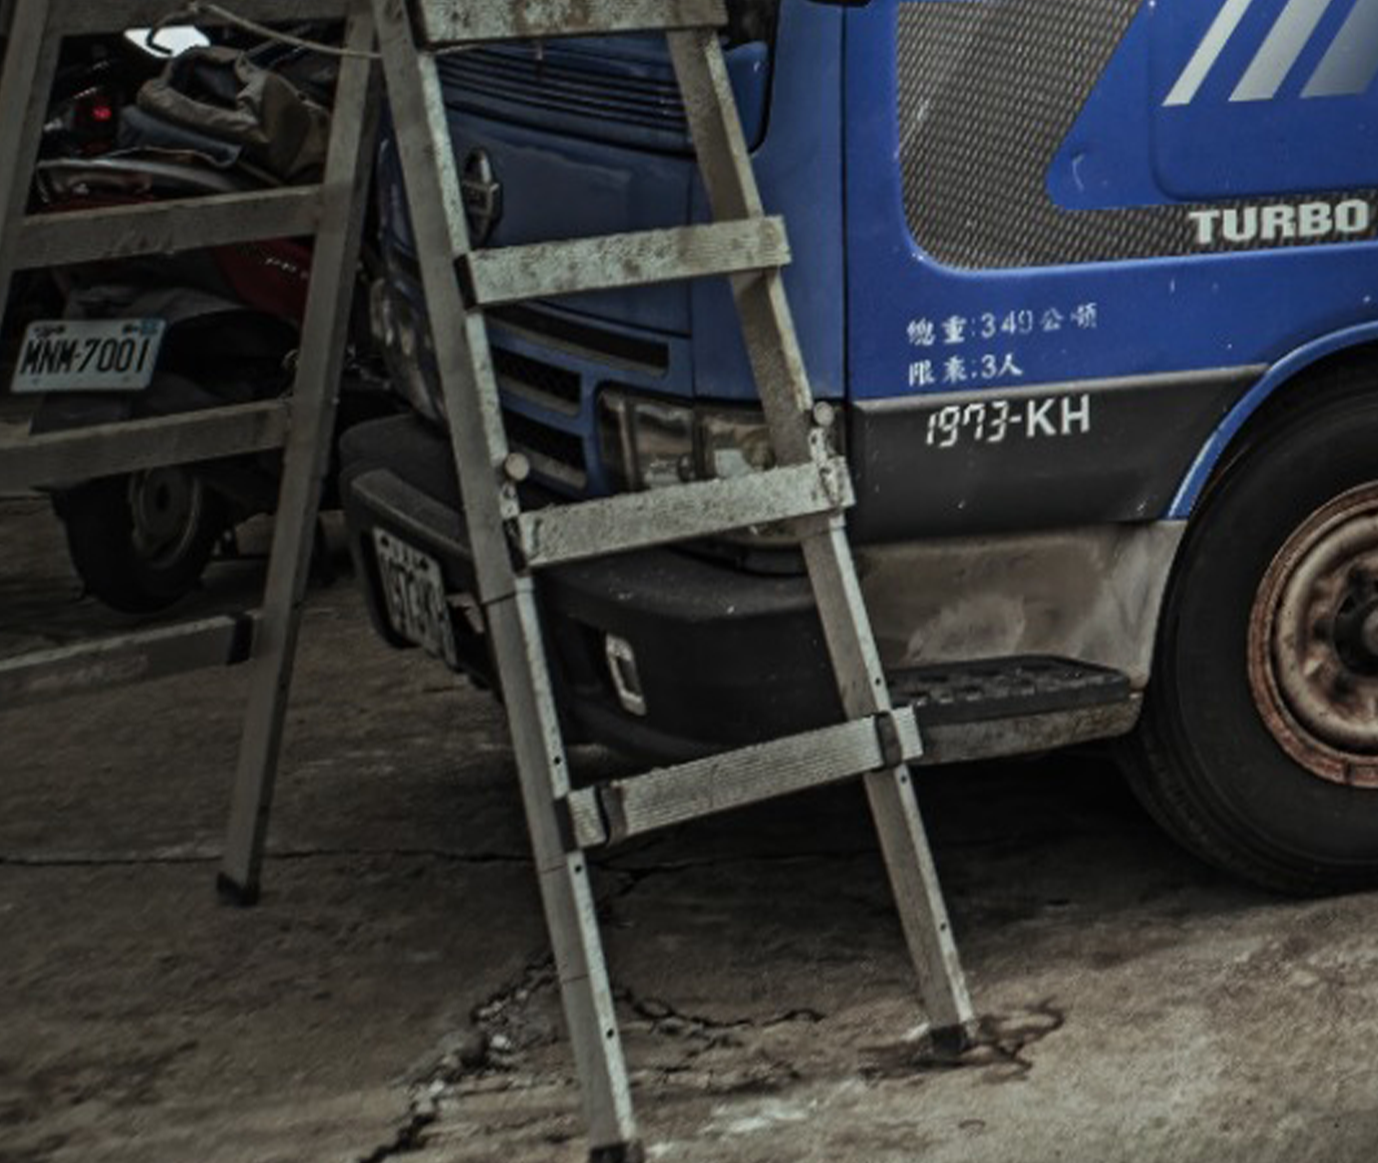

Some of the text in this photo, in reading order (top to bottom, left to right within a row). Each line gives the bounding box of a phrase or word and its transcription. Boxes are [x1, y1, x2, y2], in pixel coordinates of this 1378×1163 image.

[1188, 198, 1373, 245] TURBO
[20, 337, 151, 375] MNM-7001
[925, 393, 1091, 448] 1973-KH
